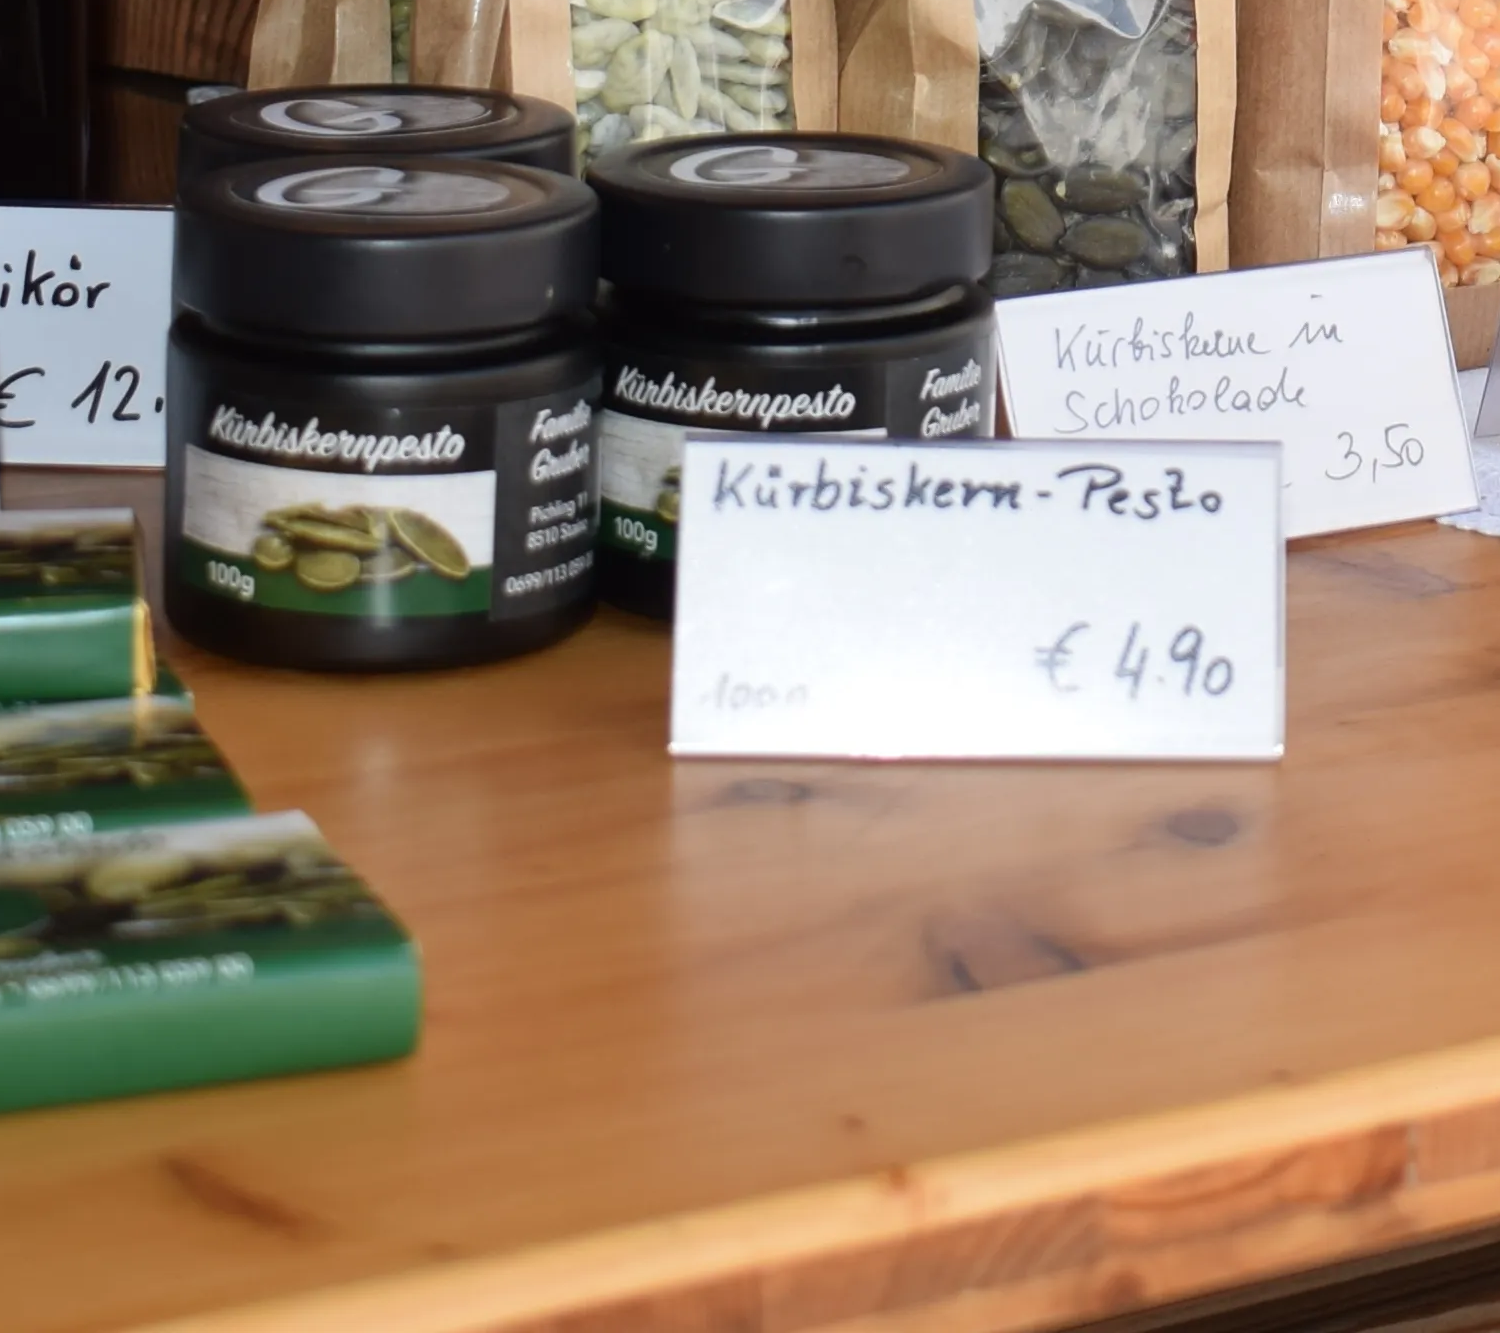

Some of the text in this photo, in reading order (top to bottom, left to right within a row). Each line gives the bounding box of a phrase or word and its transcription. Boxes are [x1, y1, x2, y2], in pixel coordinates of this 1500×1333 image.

[614, 364, 857, 430] Kürbiskernpesto
[918, 358, 983, 401] Familie
[1053, 367, 1310, 436] Schokolade
[208, 404, 467, 466] Kürbiskernpesto
[920, 397, 981, 439] Gruber
[529, 441, 591, 483] Gruber
[1322, 423, 1427, 483] 3,50
[613, 515, 658, 552] 100g
[205, 559, 257, 601] 100g
[1033, 621, 1234, 699] € 4.90
